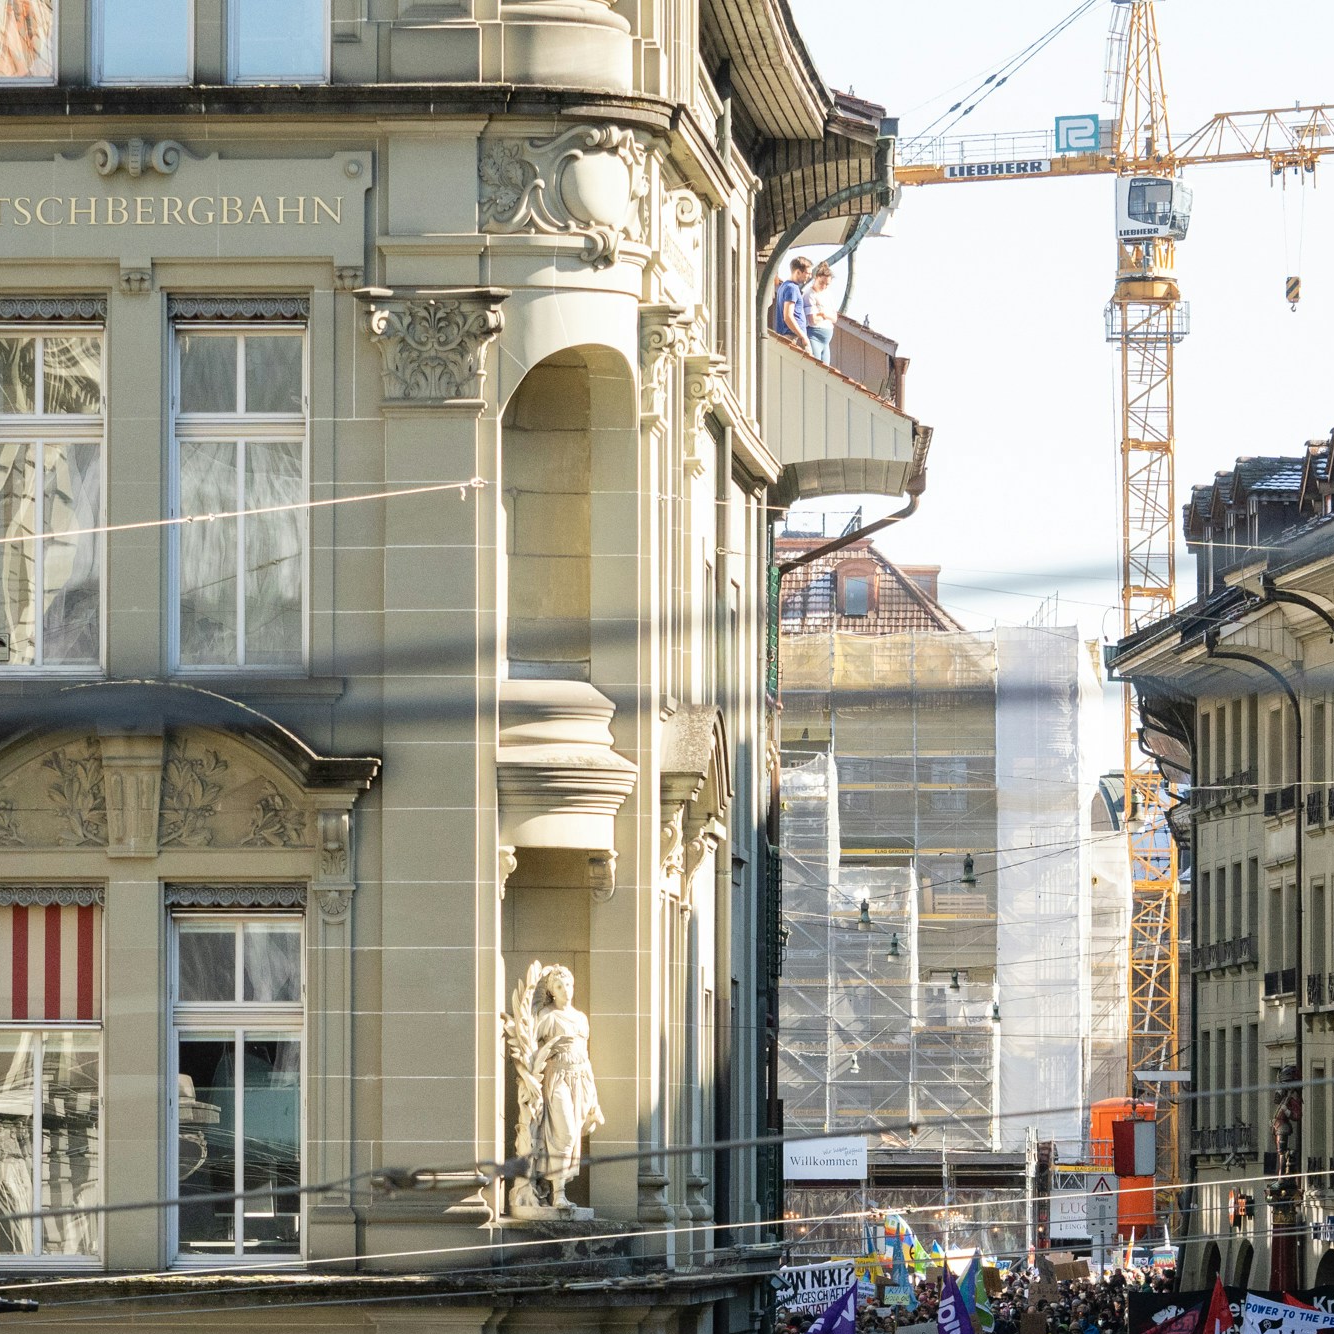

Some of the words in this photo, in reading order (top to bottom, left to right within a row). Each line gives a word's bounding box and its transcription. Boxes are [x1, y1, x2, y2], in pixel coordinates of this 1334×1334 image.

[949, 162, 1043, 178] LIEBHERR
[1118, 227, 1160, 237] LIEBHERR
[790, 1156, 858, 1167] Willkommen
[811, 1263, 854, 1289] NEXT?
[1245, 1302, 1278, 1317] POWER
[1283, 1309, 1296, 1319] TO
[1300, 1311, 1319, 1323] THE
